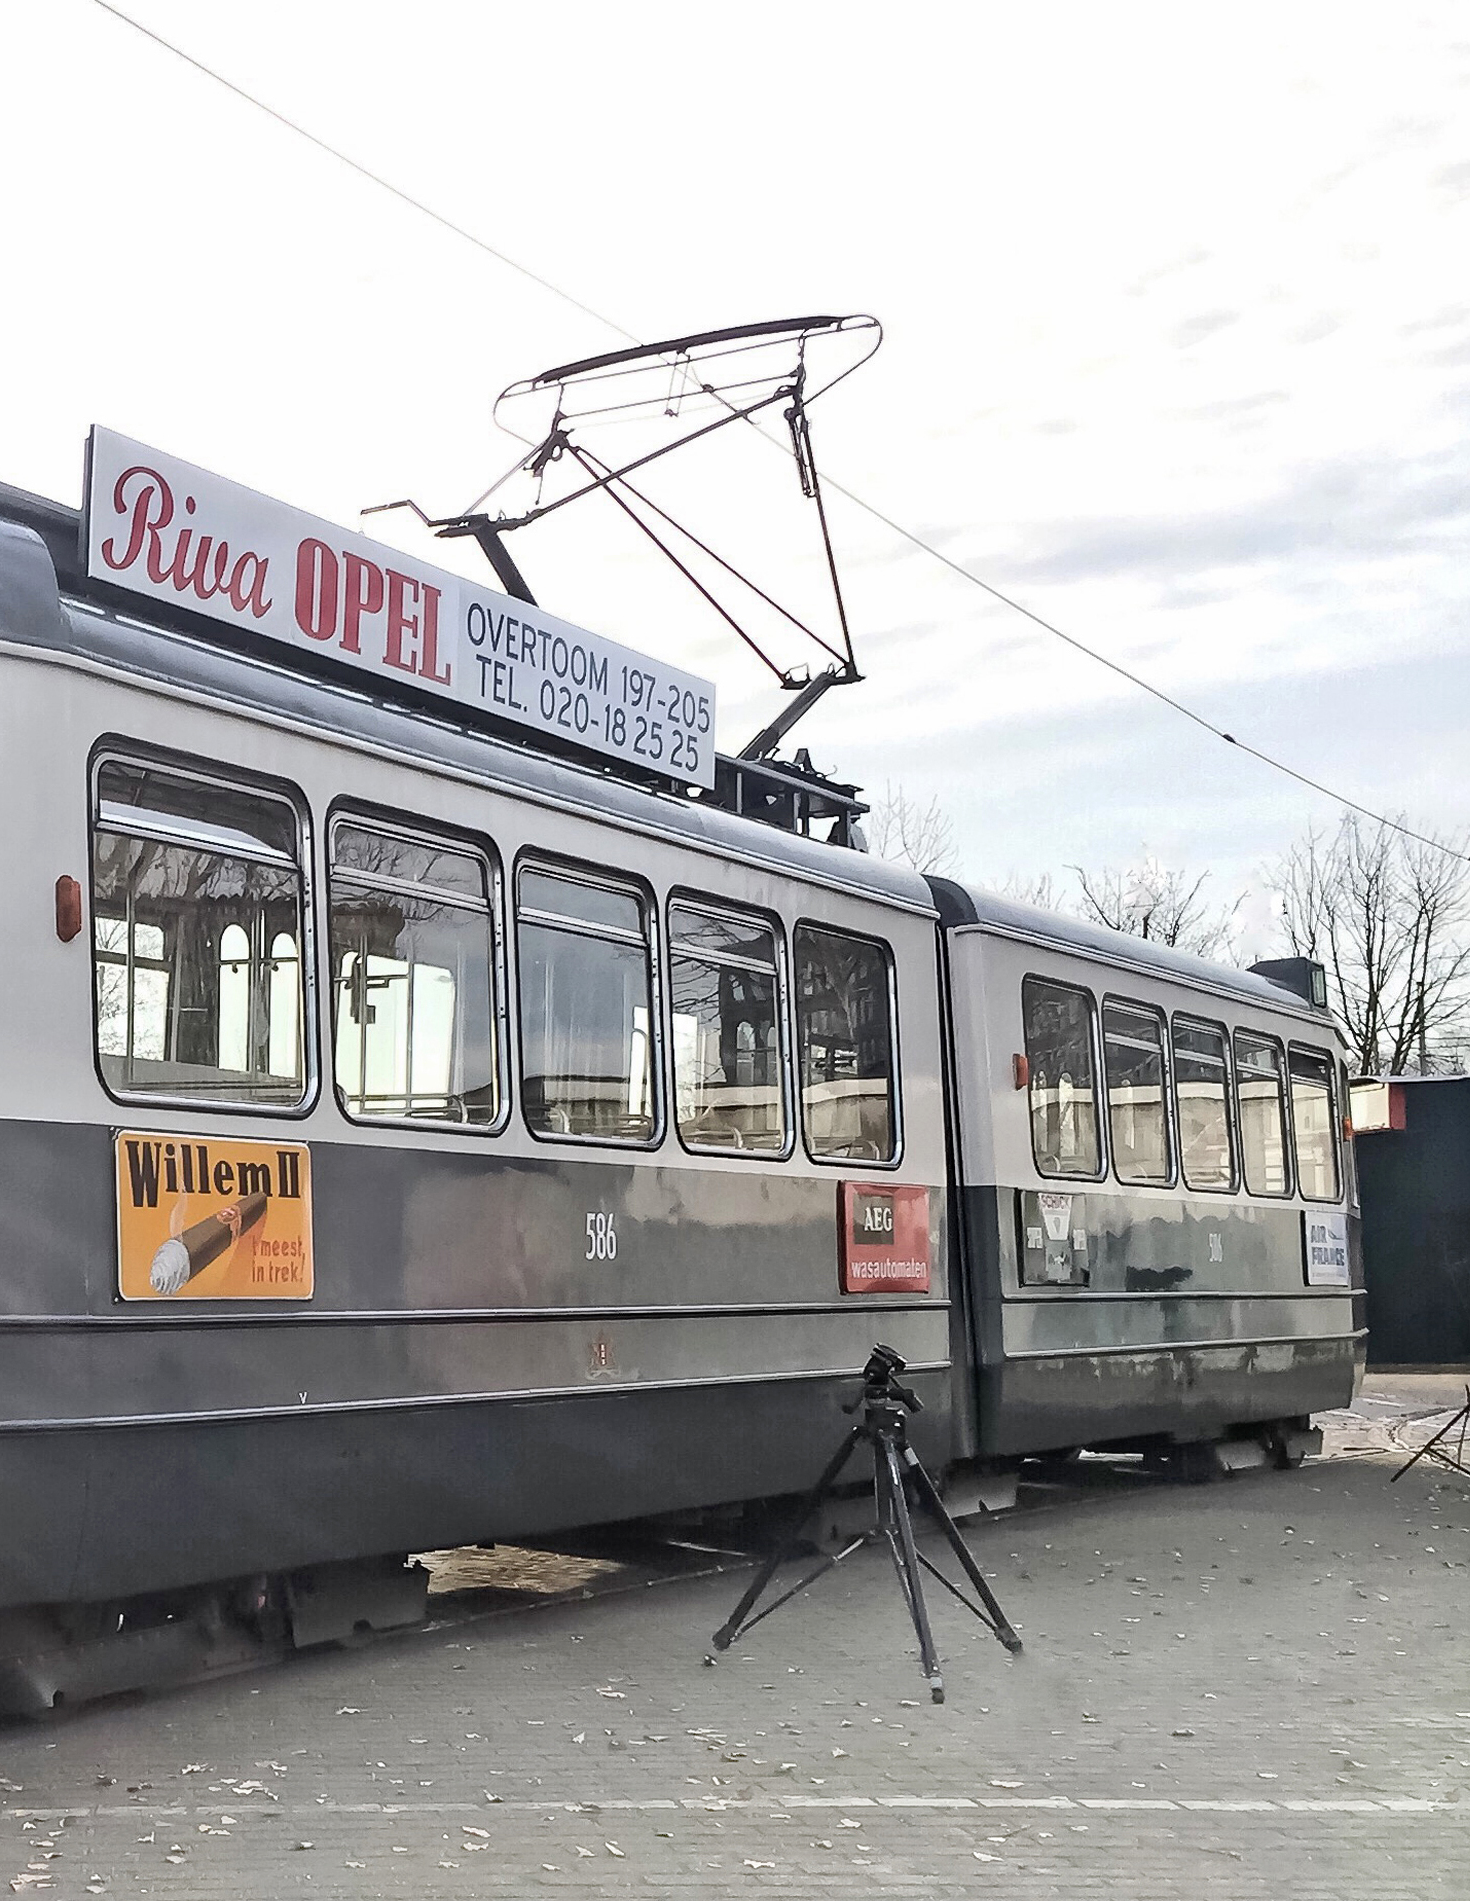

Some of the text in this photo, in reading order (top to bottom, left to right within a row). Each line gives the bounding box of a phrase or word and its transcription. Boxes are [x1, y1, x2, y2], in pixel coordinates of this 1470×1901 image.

[101, 466, 451, 687] Riva OPEL
[467, 602, 711, 734] OVERTOOM 197-205
[476, 653, 699, 772] TEL. 020-18 25 25
[125, 1140, 301, 1208] Willem II
[585, 1212, 617, 1260] 586
[863, 1206, 893, 1232] AEG
[252, 1260, 264, 1283] in
